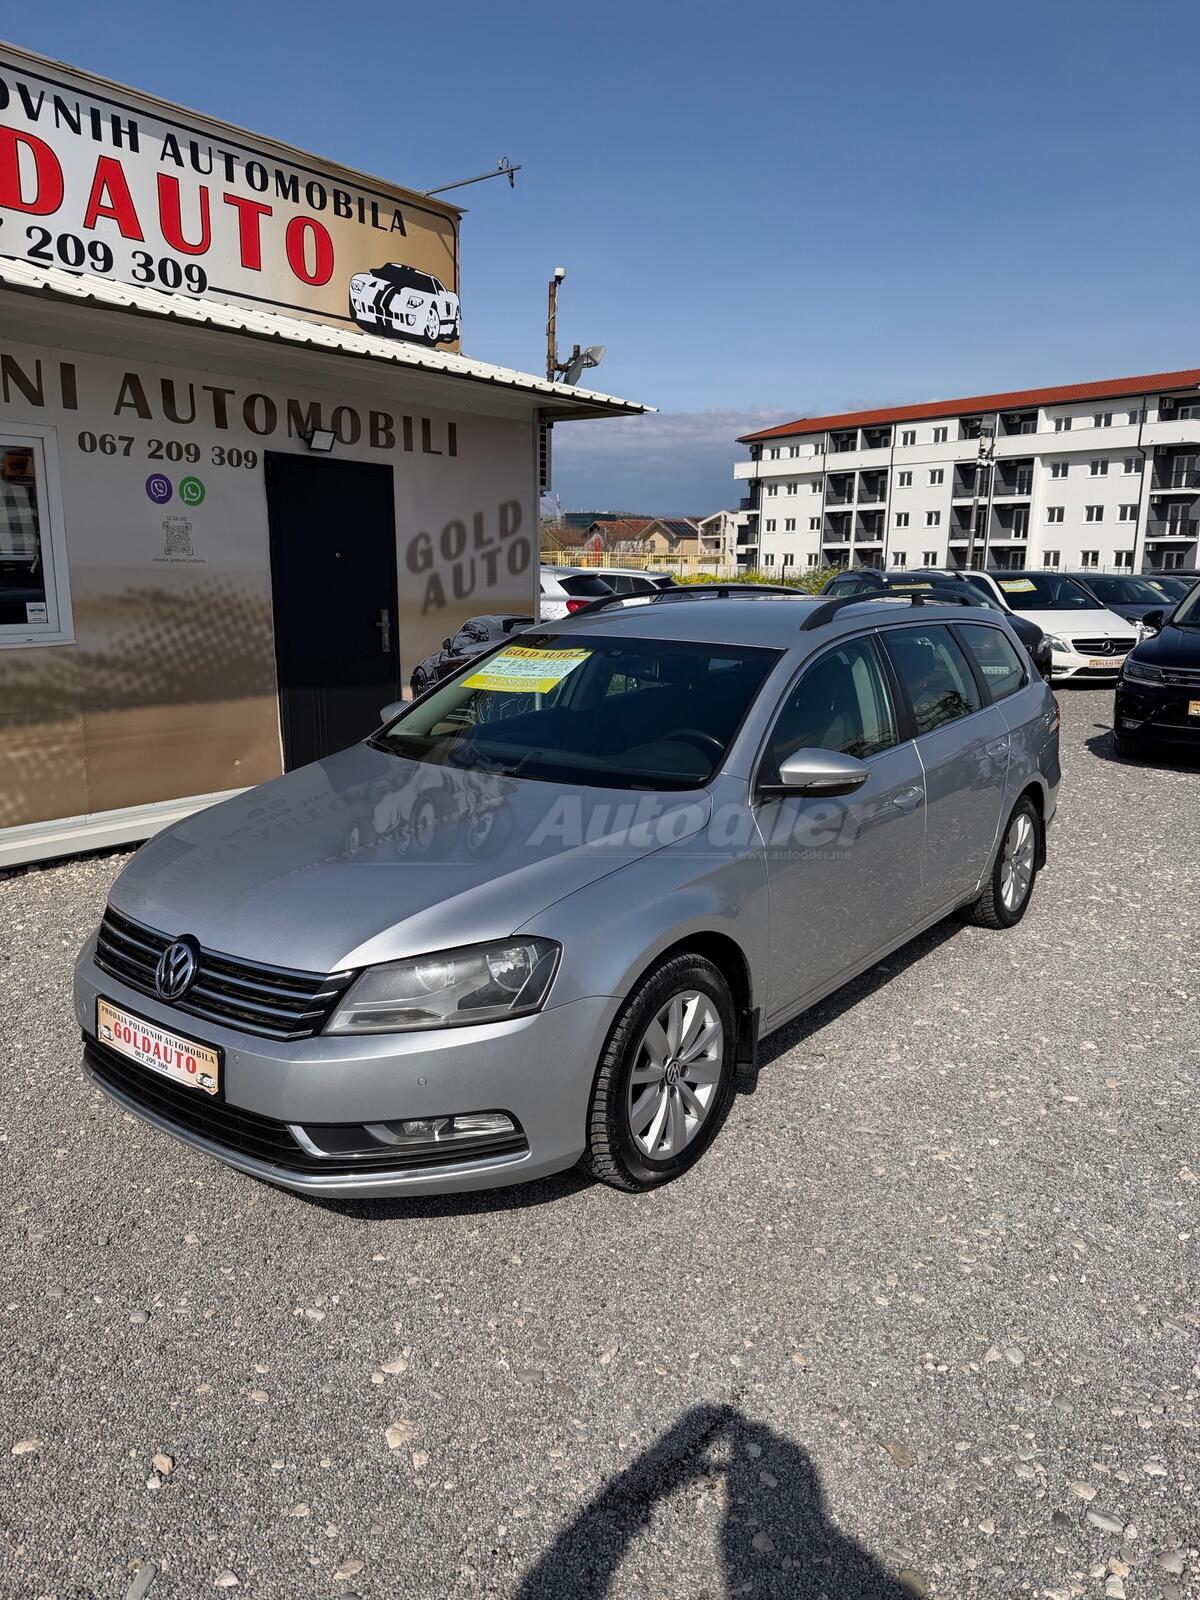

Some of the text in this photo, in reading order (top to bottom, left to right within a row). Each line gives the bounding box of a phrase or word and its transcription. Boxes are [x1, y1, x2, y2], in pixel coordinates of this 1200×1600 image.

[0, 124, 334, 286] DAUTO
[160, 132, 407, 237] AUTOMOBILA
[26, 225, 208, 294] 209 309
[1, 354, 457, 457] NI AUTOMOBILI
[78, 431, 258, 469] 067 209 309
[406, 498, 523, 575] GOLD
[422, 536, 531, 617] AUTO
[505, 648, 573, 659] GOLD AUTO
[101, 1005, 215, 1064] PRODAJA POLOVNIH AUTOMOBILA
[113, 1021, 197, 1075] GOLDAUTO
